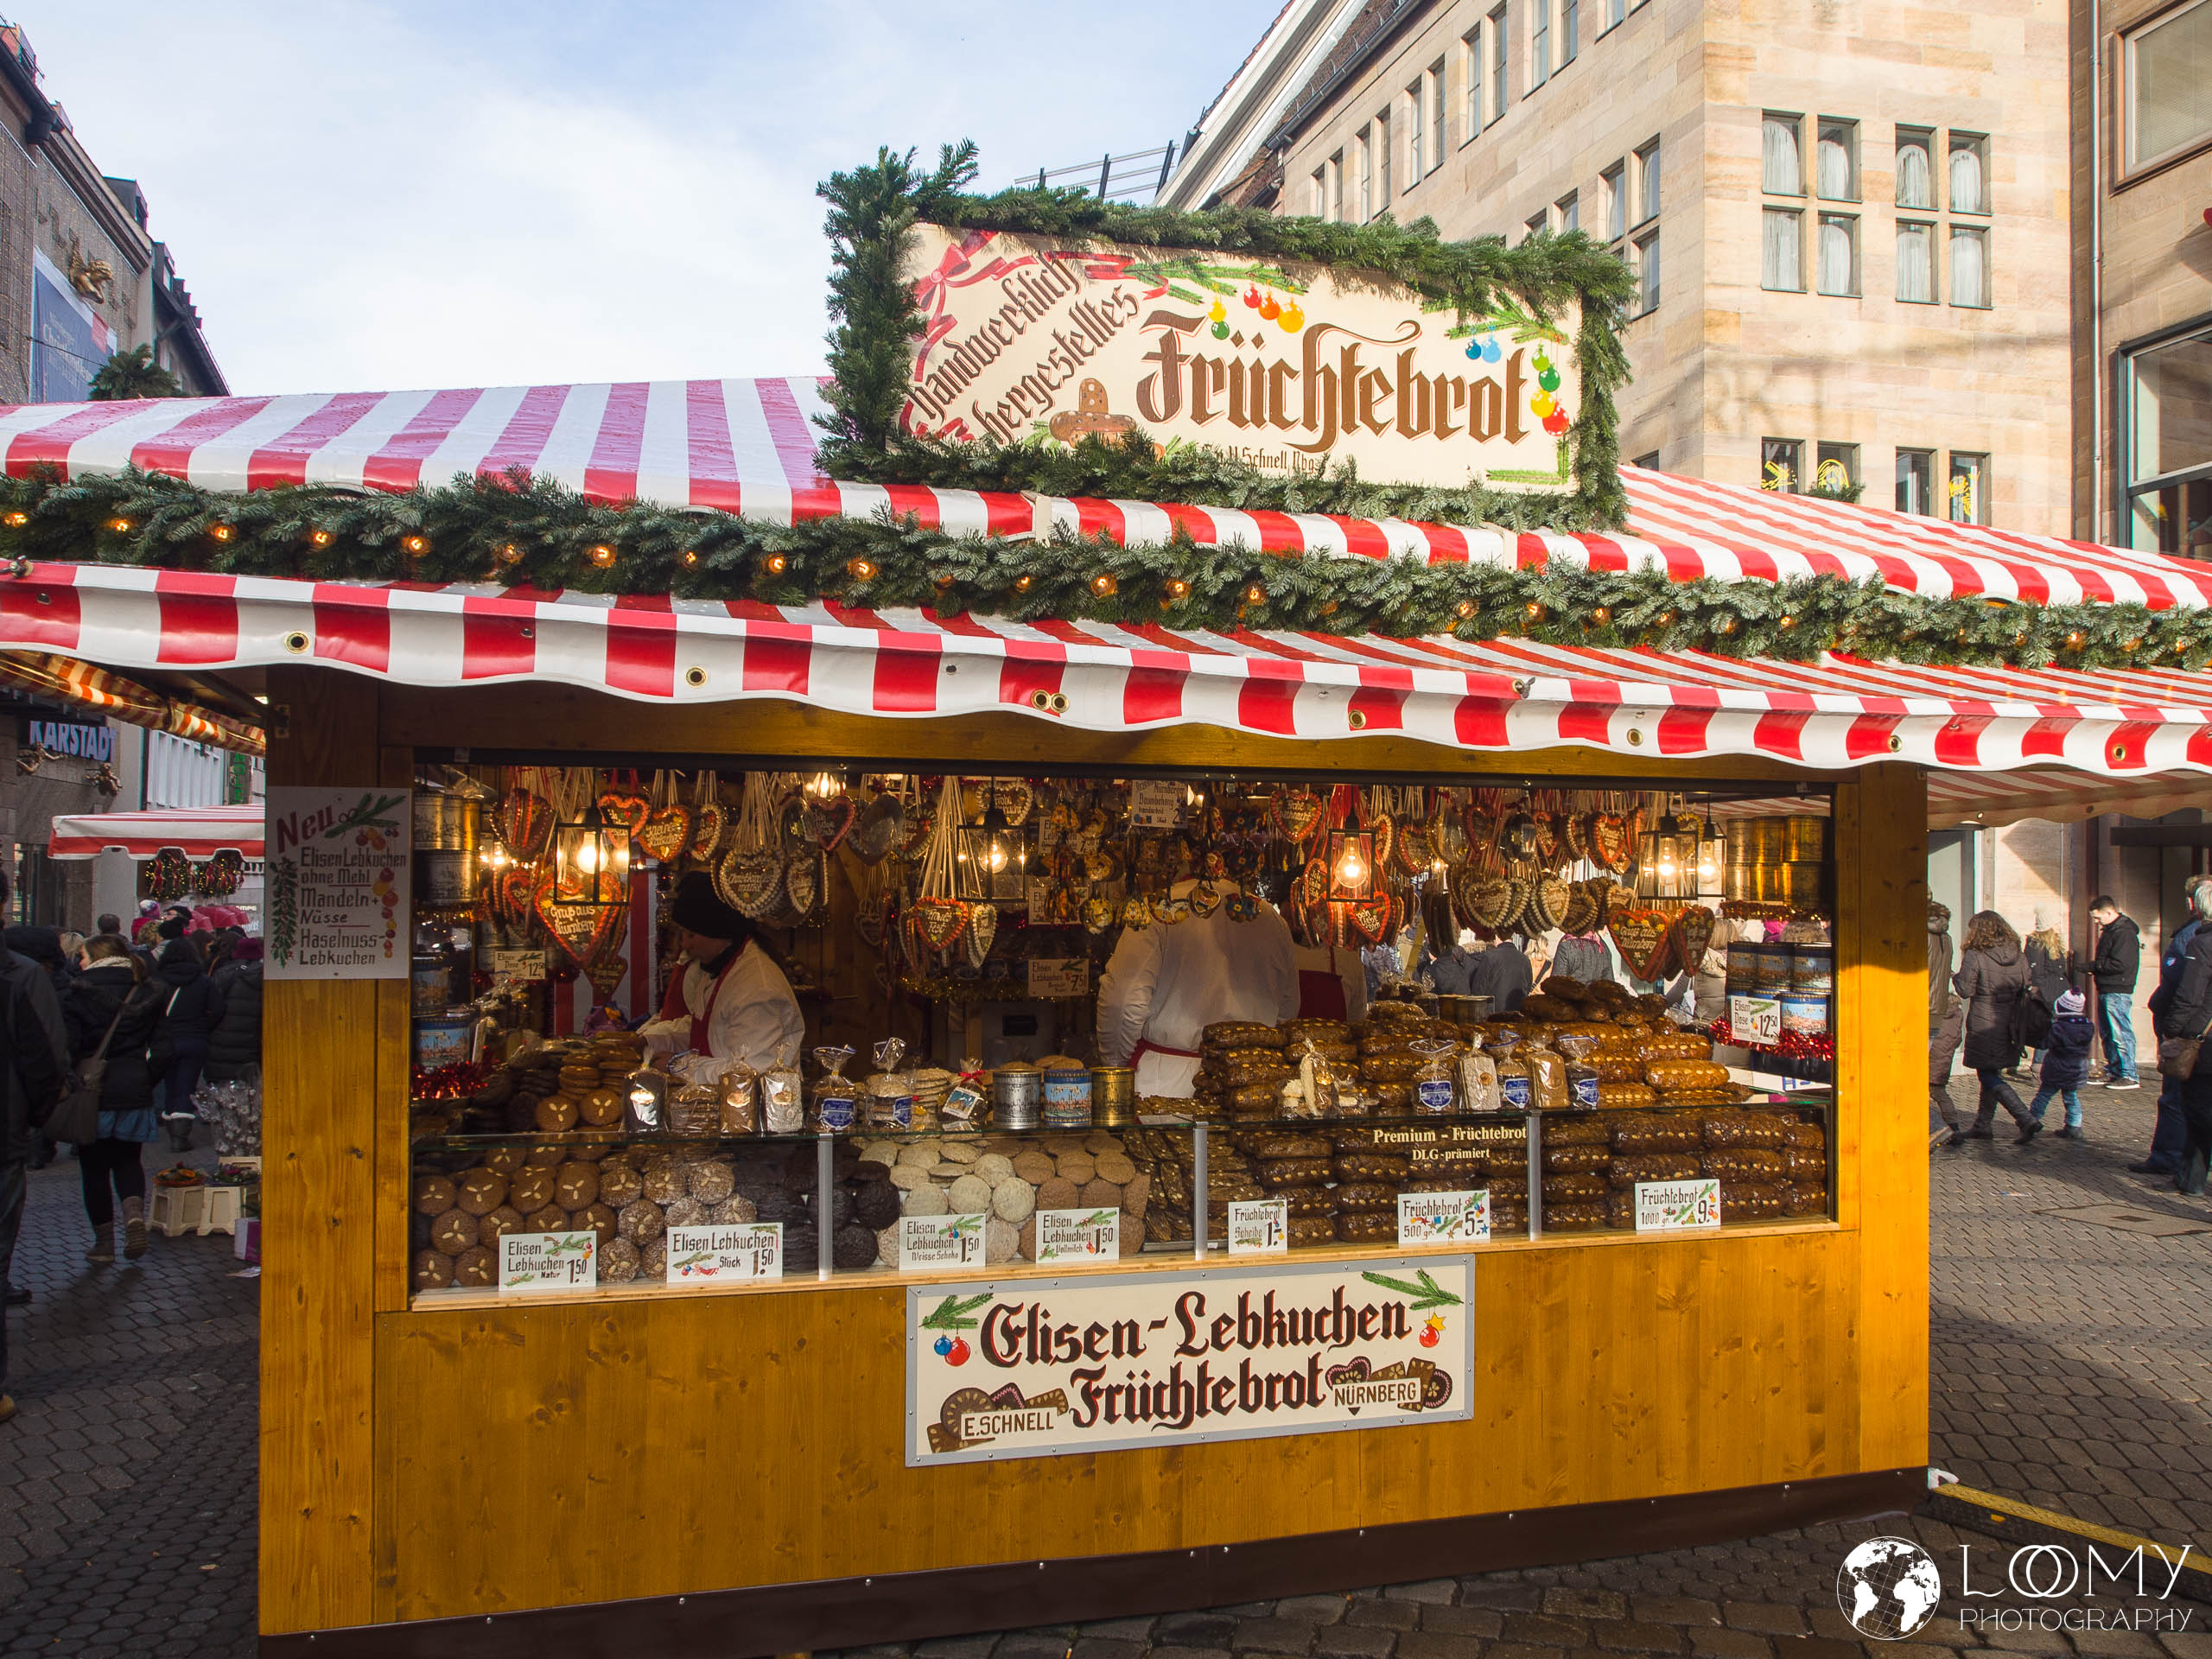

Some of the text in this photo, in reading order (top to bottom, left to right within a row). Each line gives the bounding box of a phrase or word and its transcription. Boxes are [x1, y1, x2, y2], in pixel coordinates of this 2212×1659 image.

[972, 284, 1140, 445] hergestelltes
[1136, 309, 1531, 453] Früchtebrot
[29, 721, 118, 764] KARSTADT
[276, 805, 334, 854] Neu
[301, 847, 407, 868] Elisen Lebkuchen
[302, 868, 370, 884] ohne Mehl
[301, 887, 369, 907] Mandeln
[300, 910, 347, 924] Nüsse
[555, 919, 594, 936] Nürnberg
[301, 929, 385, 948] Haselnuss-
[299, 950, 375, 965] Lebkuchen
[1373, 1128, 1436, 1144] Premium
[1452, 1126, 1528, 1141] Früchtebrot
[1642, 1185, 1698, 1205] Früchtebrot
[1402, 1198, 1463, 1217] Früchtebrot
[1043, 1214, 1072, 1229] Elisen
[1641, 1211, 1660, 1225] 1000
[907, 1220, 936, 1235] Elisen
[1235, 1226, 1262, 1239] Scheibe
[1403, 1224, 1422, 1237] 500
[672, 1230, 774, 1253] Elisen Lebkuchen
[906, 1236, 954, 1251] Lebkuchen
[1043, 1229, 1091, 1244] Lebkuchen
[508, 1241, 542, 1256] Elisen
[508, 1255, 565, 1272] Lebkuchen
[719, 1255, 741, 1268] Stück
[540, 1270, 561, 1280] Natur
[1070, 1351, 1326, 1432] Früchtebrot
[1333, 1381, 1417, 1408] NÜRNBERG
